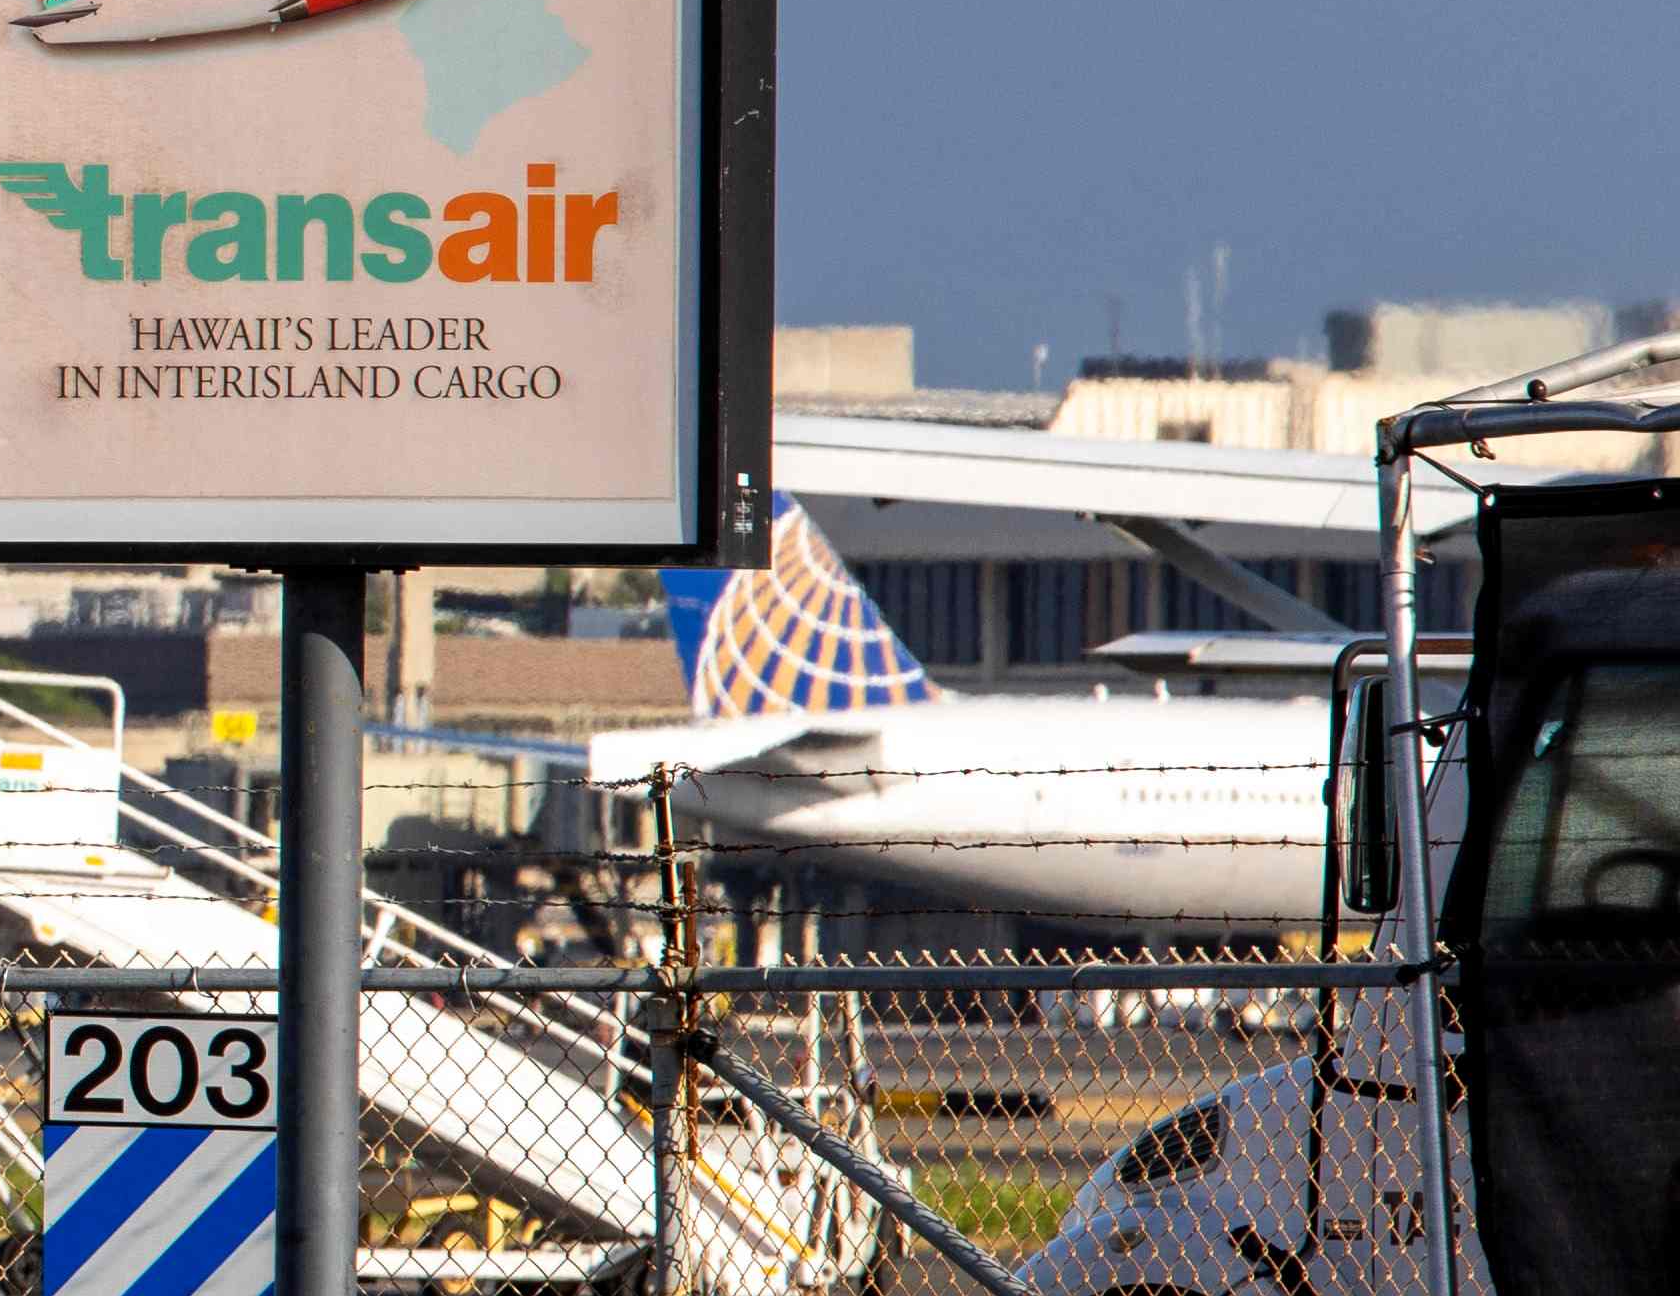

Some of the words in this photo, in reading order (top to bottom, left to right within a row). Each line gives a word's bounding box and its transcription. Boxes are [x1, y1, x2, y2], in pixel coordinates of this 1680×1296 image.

[130, 315, 314, 352] HAWAII'S
[327, 316, 491, 352] LEADER
[57, 364, 104, 400] IN
[117, 365, 402, 400] INTERISLAND
[413, 365, 562, 400] CARGO
[63, 1023, 271, 1119] 203
